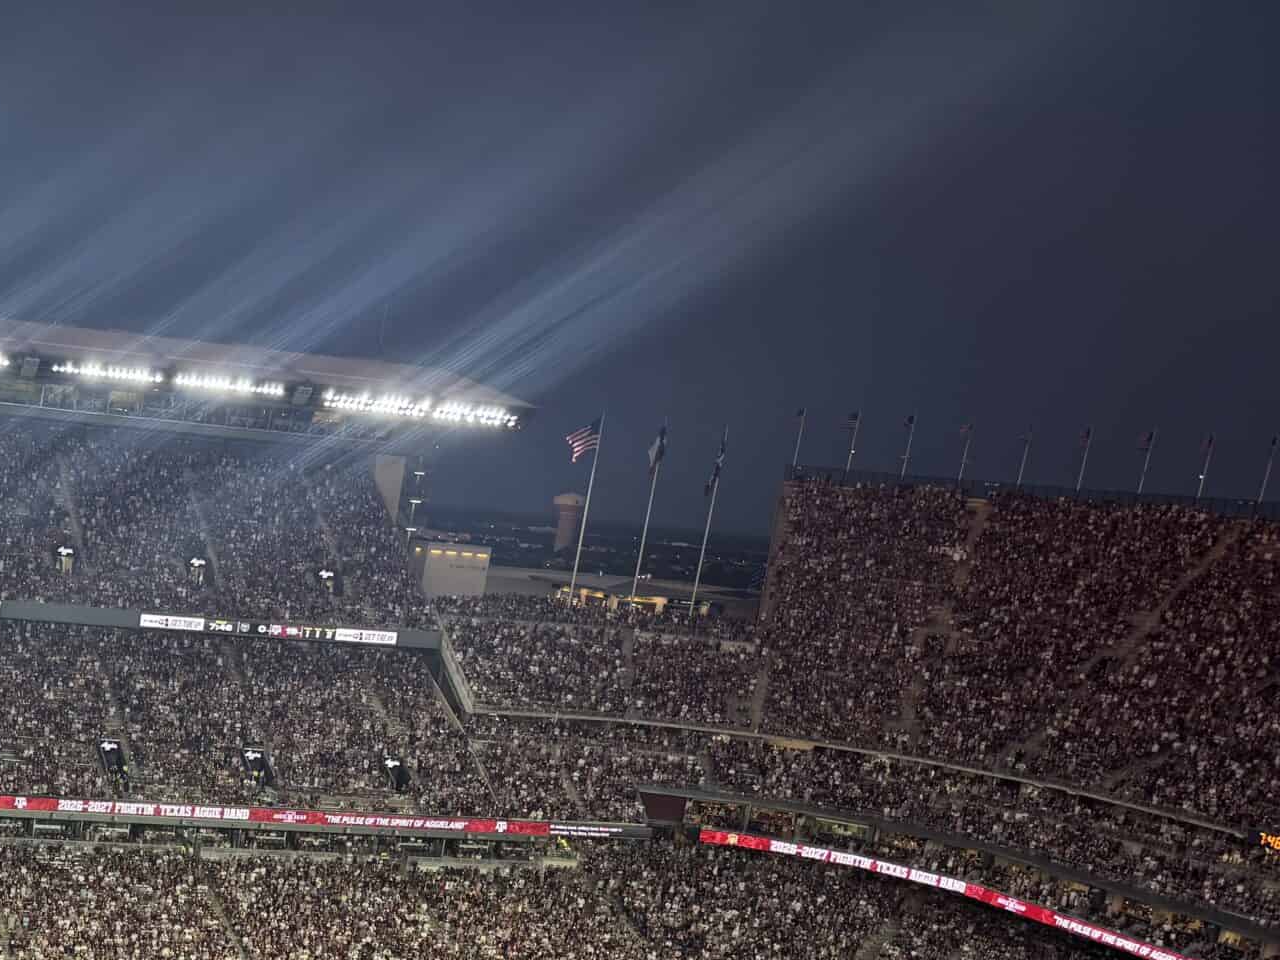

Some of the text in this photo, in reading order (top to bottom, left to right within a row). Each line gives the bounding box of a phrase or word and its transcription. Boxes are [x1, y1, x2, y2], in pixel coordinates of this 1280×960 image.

[159, 803, 192, 817] TEXAS
[194, 805, 223, 819] AGGIE
[223, 807, 249, 821] BAND
[341, 815, 363, 826] PULSE
[376, 817, 390, 827] THE
[390, 817, 413, 829] SPIRIT
